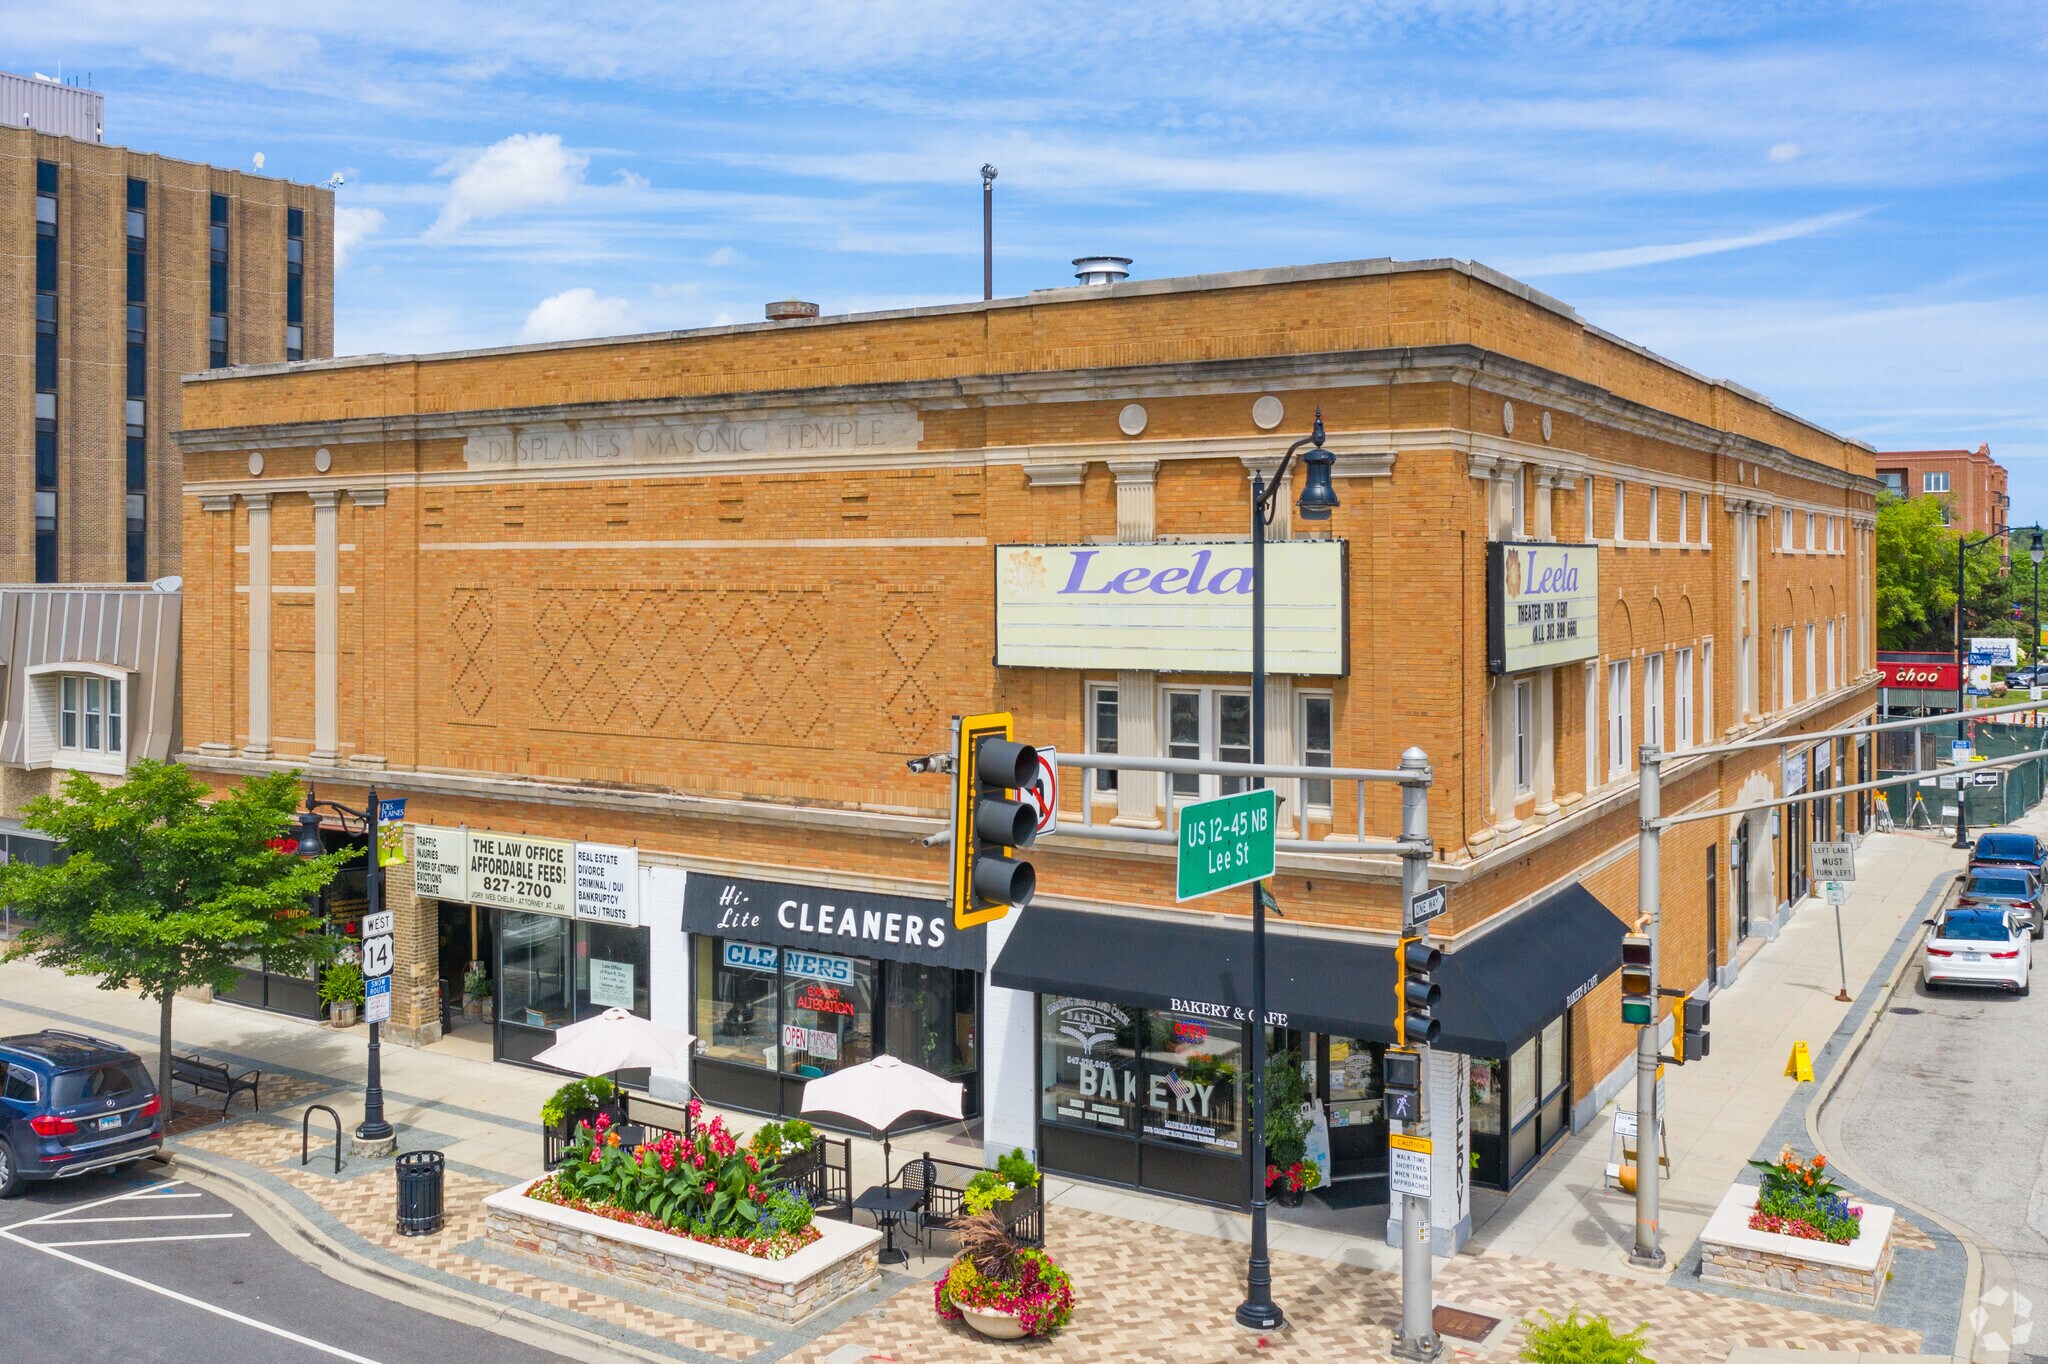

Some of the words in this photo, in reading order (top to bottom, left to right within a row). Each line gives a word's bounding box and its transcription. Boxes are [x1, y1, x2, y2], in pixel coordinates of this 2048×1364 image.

[645, 427, 755, 456] MASONIC
[781, 419, 886, 449] TEMPLE
[1056, 550, 1254, 595] Leela
[1524, 550, 1578, 595] Leela
[1518, 603, 1541, 622] THEATER
[1544, 602, 1554, 620] FOR
[1895, 668, 1938, 683] choo
[381, 809, 404, 818] PLAINES
[1188, 821, 1206, 848] US
[1209, 811, 1248, 843] 12-45
[1251, 807, 1268, 833] NB
[416, 836, 437, 848] TRAFFIC
[416, 850, 438, 860] INJURIES
[473, 838, 495, 854] THE
[498, 842, 521, 858] LAW
[525, 846, 564, 863] OFFICE
[578, 851, 594, 862] REAL
[595, 854, 618, 865] ESTATE
[1208, 849, 1231, 874] Lee
[1235, 841, 1249, 866] St
[416, 862, 430, 872] POWER
[431, 863, 437, 872] OF
[437, 865, 459, 875] ATTORNEY
[1822, 857, 1843, 866] MUST
[471, 856, 533, 880] AFFORDABLE
[537, 863, 566, 884] FEES!
[578, 864, 605, 877] DIVORCE
[416, 874, 442, 884] EVICTIONS
[483, 876, 552, 898] 827-2700
[578, 878, 607, 891] CRIMINAL
[612, 884, 624, 892] DUI
[416, 882, 440, 894] PROBATE
[719, 885, 749, 906] Hi-
[471, 891, 484, 899] JORY
[497, 895, 515, 903] CHELIN
[518, 898, 544, 908] ATTORNEY
[578, 891, 619, 905] BANKRUPTCY
[578, 906, 597, 915] WILLS
[602, 907, 626, 919] TRUSTS
[1415, 901, 1426, 915] ONE
[368, 915, 390, 931] WEST
[717, 908, 760, 929] Lite
[777, 900, 946, 948] CLEANERS
[369, 943, 387, 969] 14
[727, 944, 848, 979] CLEANERS
[370, 986, 387, 995] ROUTE
[371, 979, 386, 988] SNOW
[807, 985, 840, 999] EXPERT
[1566, 985, 1584, 1008] BAKERY
[1171, 998, 1231, 1018] BAKERY
[1233, 1007, 1245, 1020] &
[1066, 1011, 1108, 1025] BAKERY
[785, 1026, 806, 1049] OPEN
[1174, 1023, 1208, 1039] OPEN
[809, 1031, 836, 1050] MASKS
[1080, 1065, 1215, 1117] BAKERY
[1397, 1139, 1425, 1149] CAUTION
[1456, 1054, 1464, 1221] AKERY
[1395, 1161, 1428, 1173] SHORTENED
[1395, 1170, 1410, 1178] WHEN
[1412, 1173, 1428, 1181] TRAIN
[1393, 1178, 1430, 1191] APPROACHES
